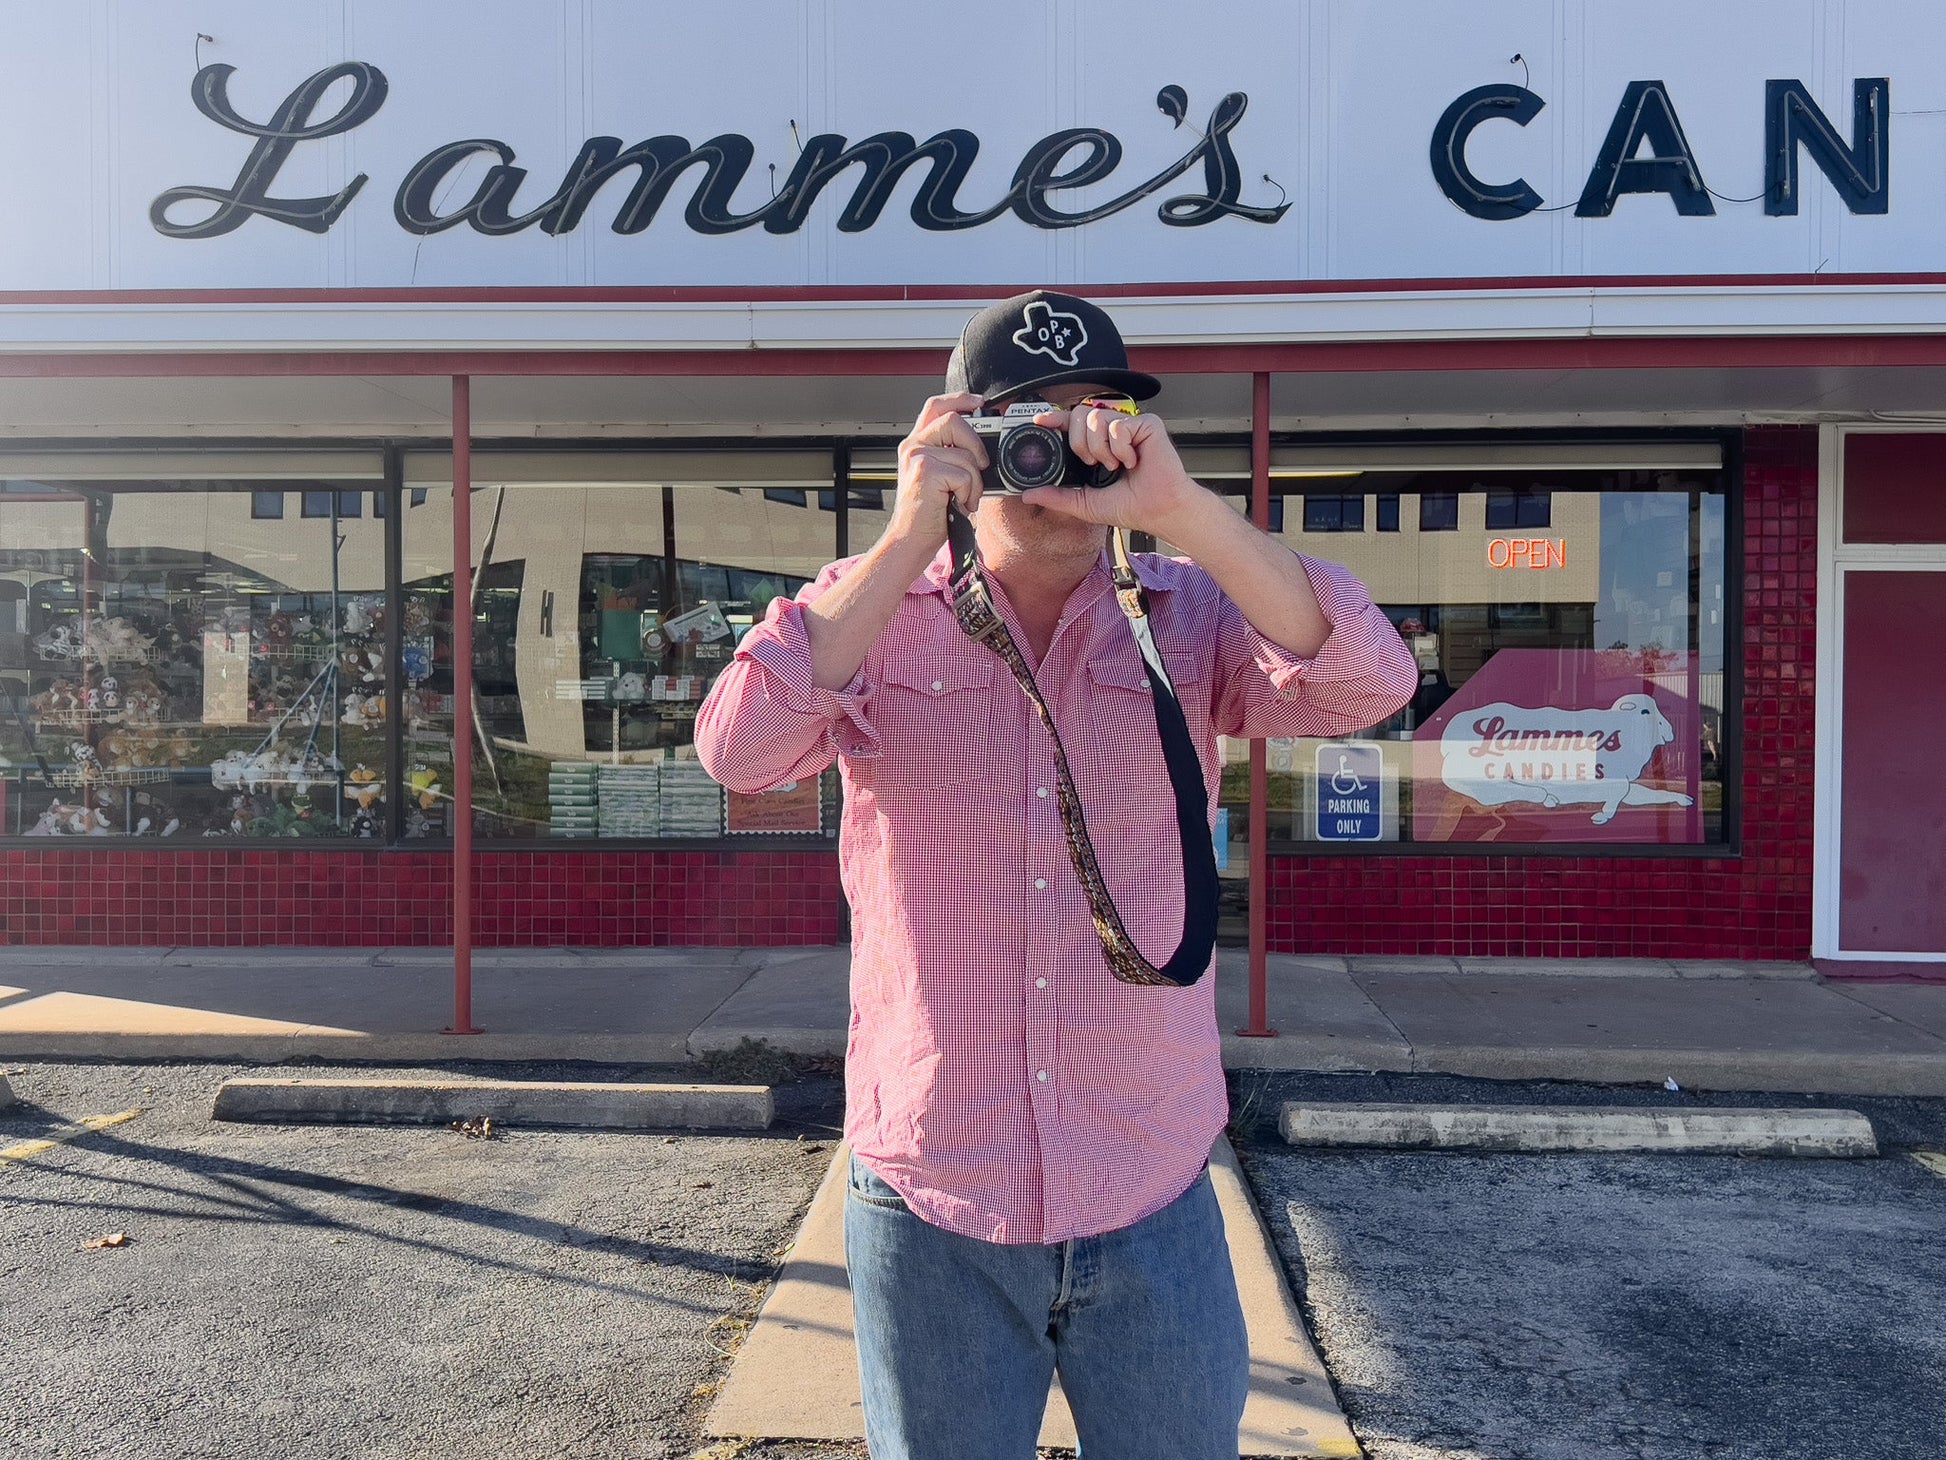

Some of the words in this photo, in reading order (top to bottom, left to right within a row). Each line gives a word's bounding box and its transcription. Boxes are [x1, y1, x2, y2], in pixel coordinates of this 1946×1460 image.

[148, 61, 1293, 240] Lamme's
[1430, 77, 1890, 221] CAN
[1011, 407, 1050, 415] PENTAX
[1487, 538, 1566, 570] OPEN
[1468, 716, 1622, 757] Lammes
[1484, 762, 1605, 781] CANDIES
[1328, 799, 1370, 814] PARKING
[1336, 819, 1362, 834] ONLY
